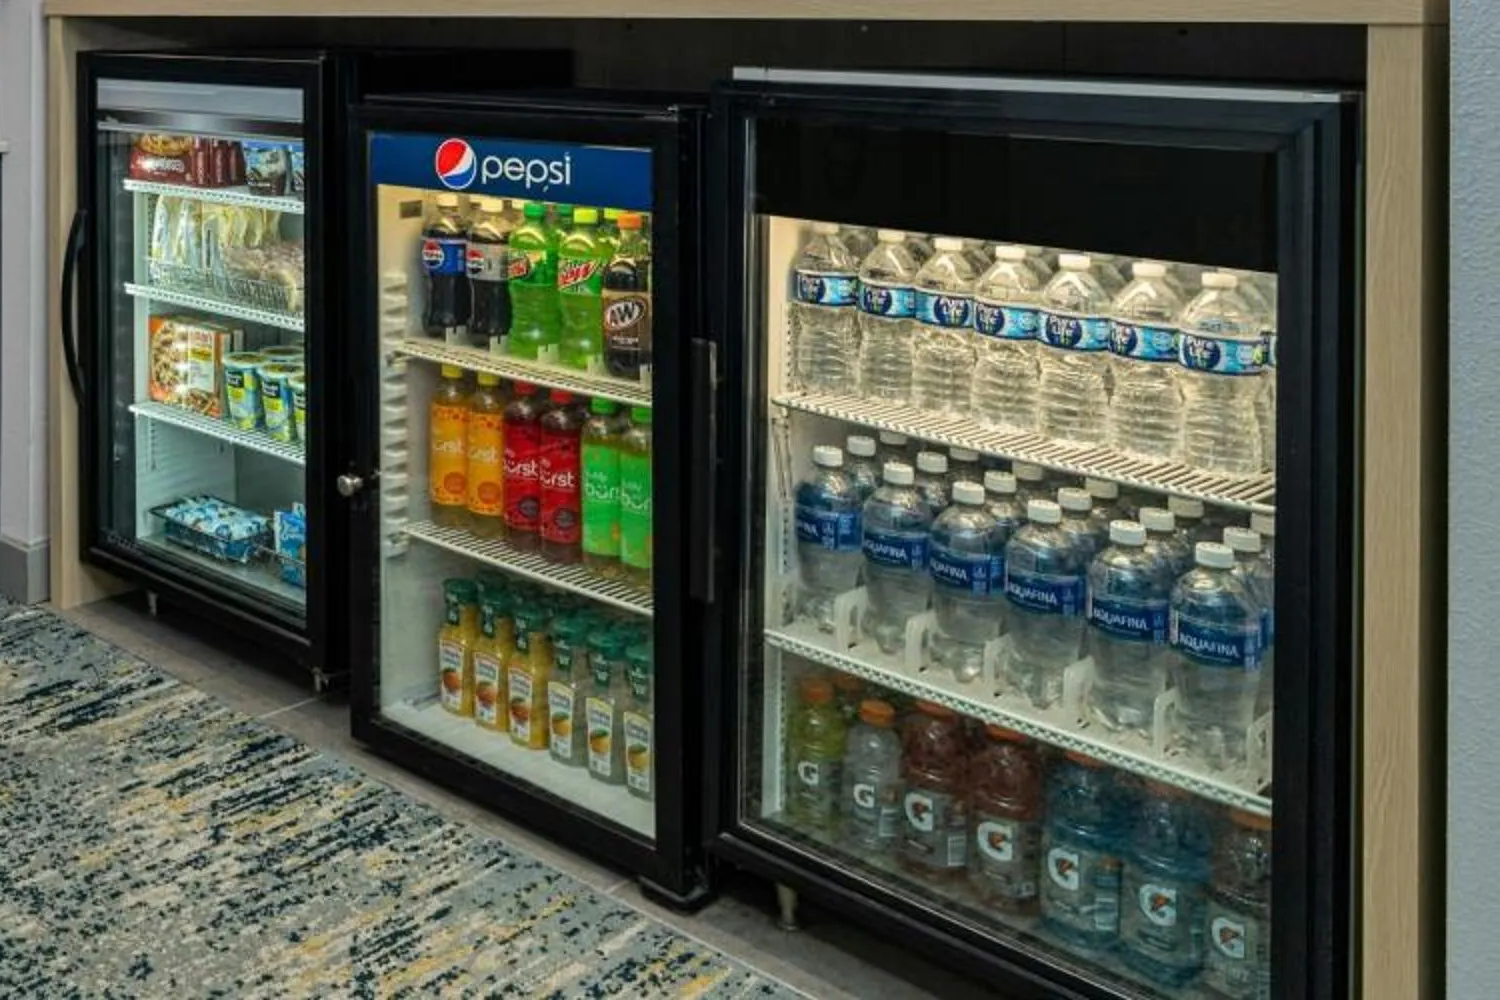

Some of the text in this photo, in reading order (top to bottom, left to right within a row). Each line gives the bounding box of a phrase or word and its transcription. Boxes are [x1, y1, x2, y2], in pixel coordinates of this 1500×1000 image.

[481, 151, 572, 190] pepsi
[1180, 633, 1239, 658] AQUAFINA
[798, 761, 819, 785] G
[853, 784, 875, 808] G
[905, 792, 933, 832] G
[977, 821, 1013, 861] G
[1047, 847, 1079, 890] G
[1139, 883, 1177, 927] G
[1211, 917, 1245, 959] G
